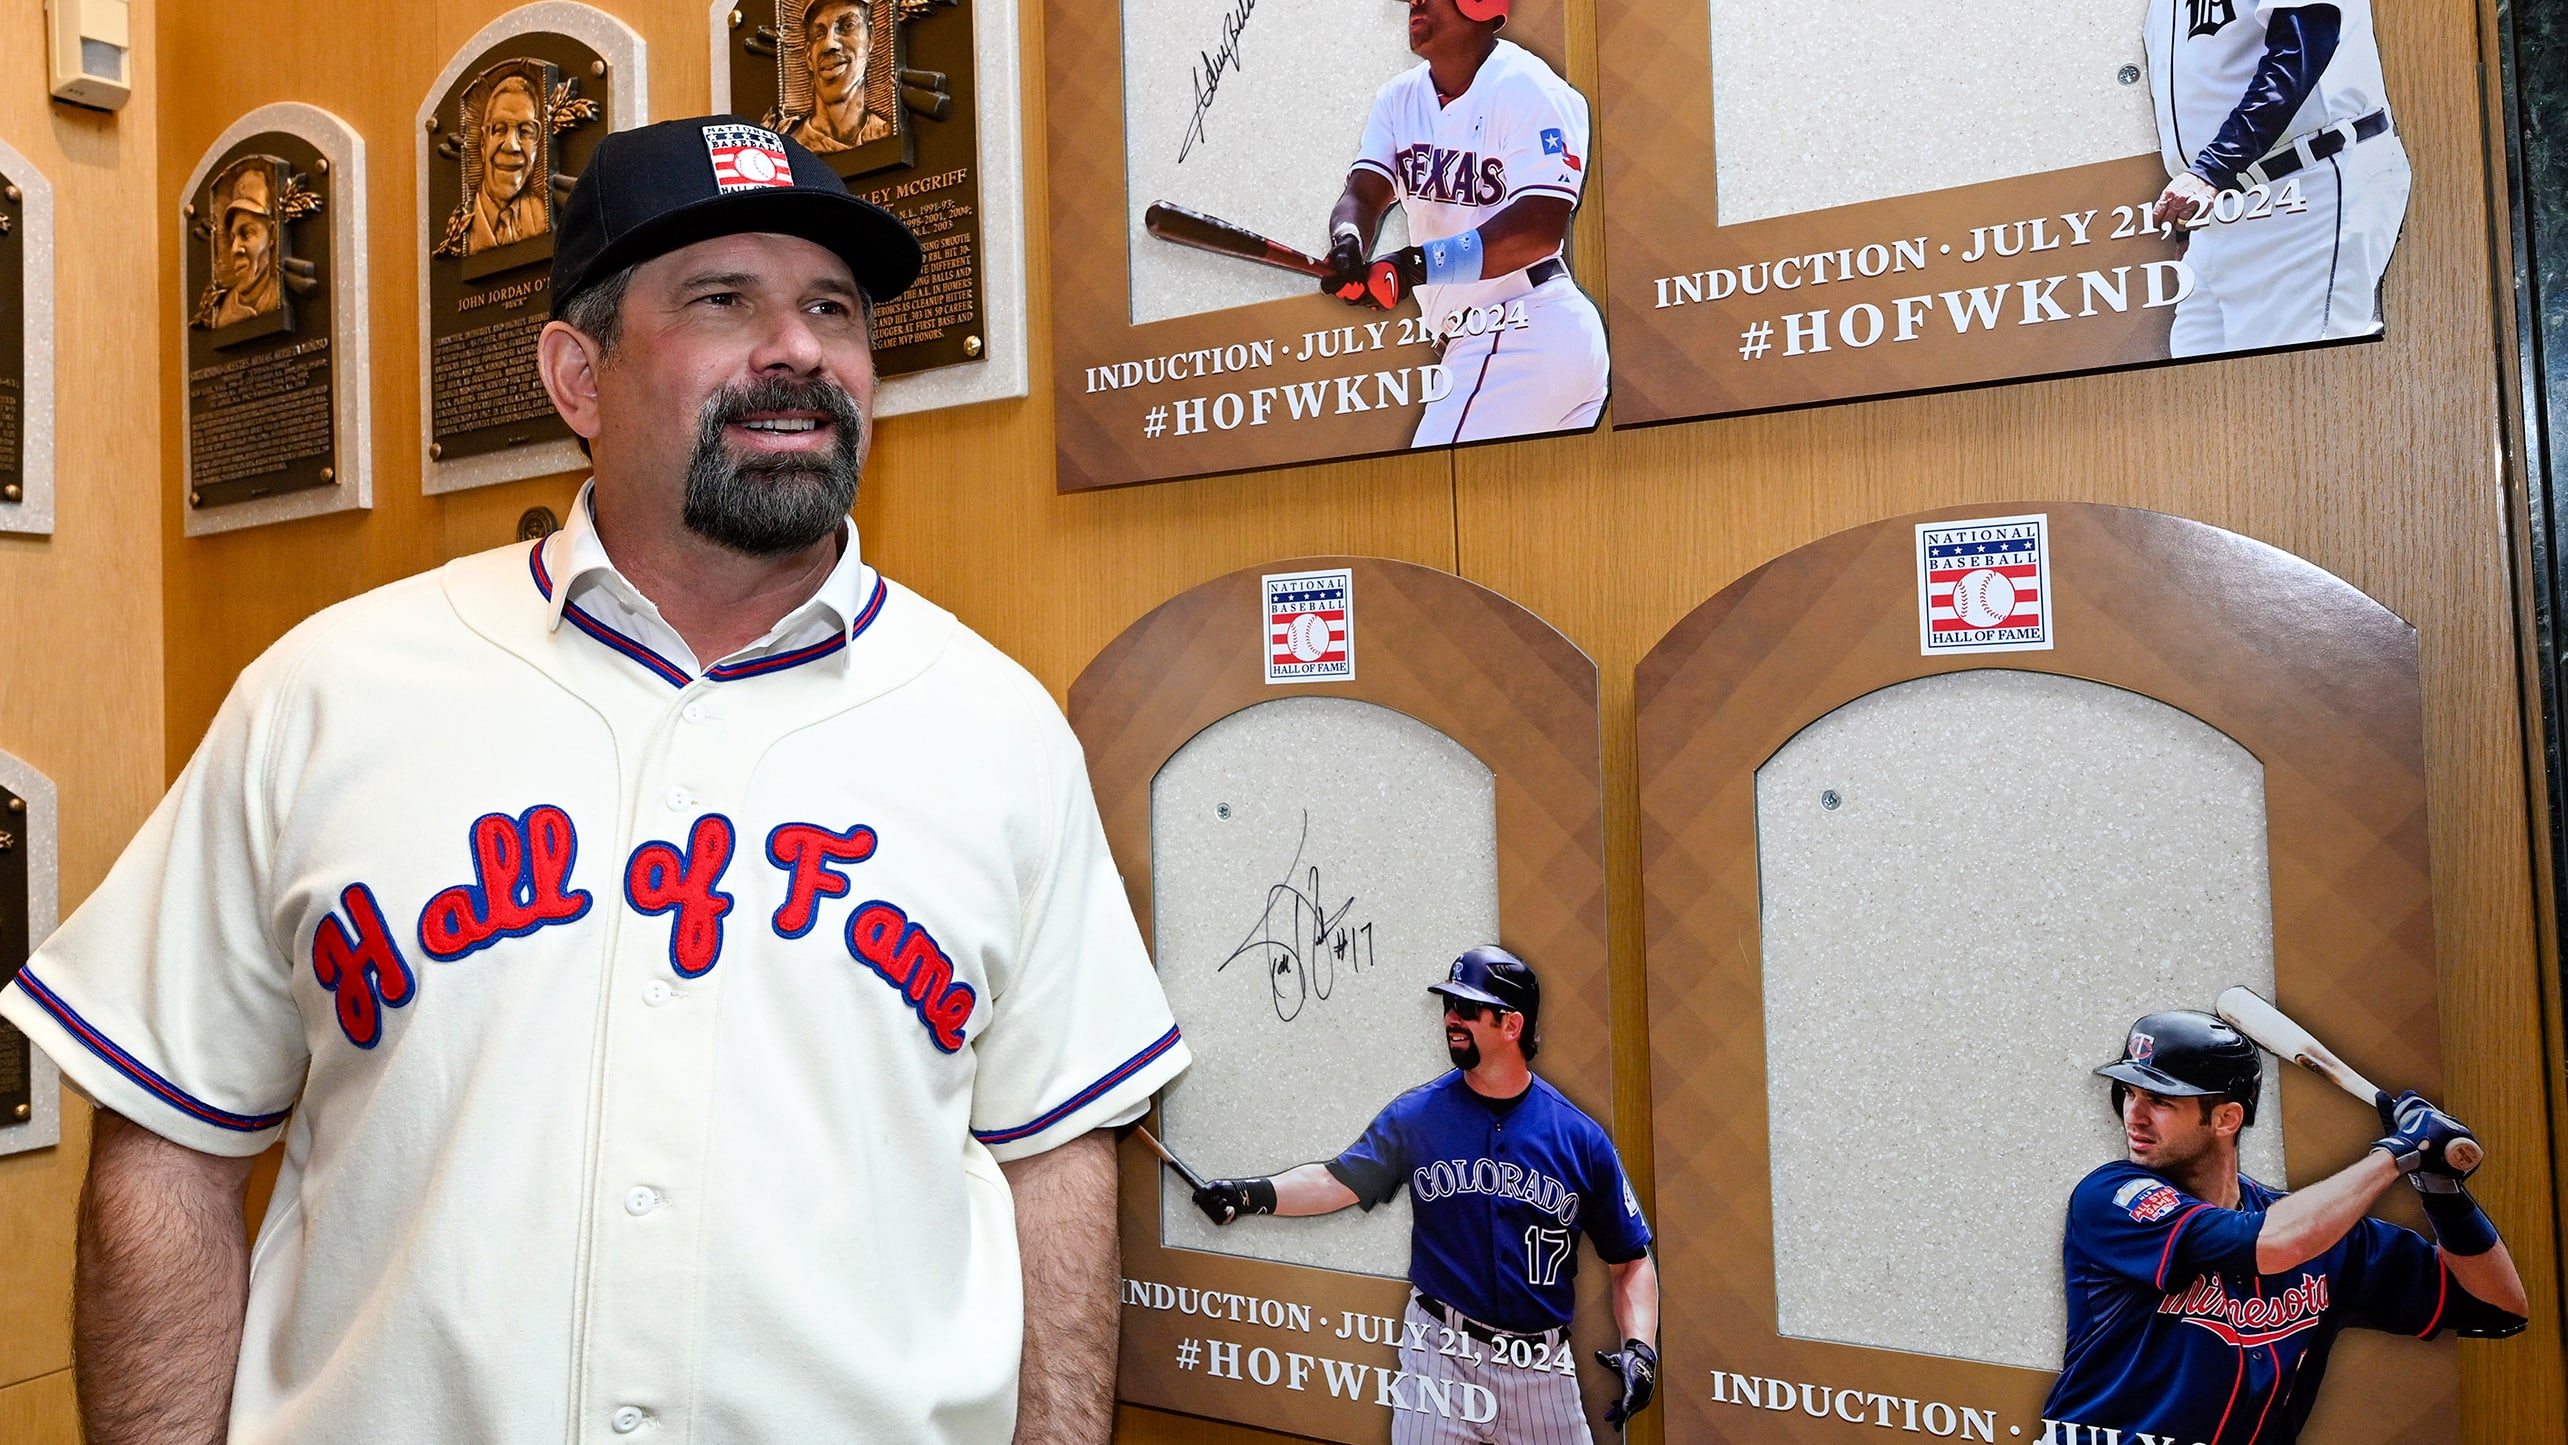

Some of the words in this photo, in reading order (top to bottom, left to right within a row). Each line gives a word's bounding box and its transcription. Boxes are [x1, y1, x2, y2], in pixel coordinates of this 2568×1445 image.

[707, 126, 778, 140] NATIONAL
[712, 140, 783, 154] BASEBALL
[896, 168, 968, 200] MCGRIFF
[1396, 143, 1507, 208] TEXAS
[941, 232, 971, 248] SMOOTH
[1653, 237, 1930, 309] INDUCTION
[1963, 210, 2099, 265] JULY
[2110, 204, 2173, 241] 21,
[2185, 178, 2308, 229] 2024
[931, 255, 972, 273] DIFFERENT
[932, 270, 954, 284] BALLS
[955, 266, 972, 279] AND
[458, 293, 486, 312] JOHN
[488, 281, 532, 304] JORDAN
[933, 283, 942, 295] IN
[943, 277, 973, 293] HOMERS
[901, 301, 911, 312] AS
[912, 294, 944, 310] CLEANUP
[946, 288, 973, 303] HITTER
[1738, 260, 2197, 363] #HOFWKND
[879, 315, 894, 328] AND
[895, 312, 908, 324] HIT
[925, 307, 933, 319] IN
[944, 299, 973, 315] CAREER
[905, 322, 915, 334] AT
[915, 318, 936, 332] FIRST
[938, 314, 956, 328] BASE
[957, 311, 974, 323] AND
[898, 333, 914, 346] MVP
[1085, 338, 1274, 394] INDUCTION
[1297, 320, 1390, 362] JULY
[1398, 315, 1438, 348] 21,
[1449, 301, 1530, 339] 2024
[1143, 364, 1456, 440] #HOFWKND
[1928, 526, 2036, 545] NATIONAL
[1929, 552, 2037, 570] BASEBALL
[1271, 578, 1344, 593] NATIONAL
[1271, 600, 1345, 613] BASEBALL
[1933, 631, 1972, 644] HALL
[1975, 630, 1995, 642] OF
[1998, 627, 2041, 641] FAME
[1273, 664, 1300, 675] HALL
[1301, 663, 1316, 674] OF
[1317, 662, 1347, 673] FAME
[312, 804, 593, 1050] Hall
[624, 812, 736, 979] of
[764, 822, 977, 1055] Fame
[1333, 921, 1374, 973] #17
[1412, 1157, 1580, 1227] COLORADO
[2134, 1202, 2151, 1218] ALL
[2149, 1187, 2174, 1203] STAR
[2146, 1195, 2173, 1215] GAME
[1524, 1225, 1571, 1286] 17
[1121, 1278, 1313, 1333] INDUCTION
[1336, 1311, 1431, 1352] JULY
[1439, 1327, 1482, 1367] 21,
[1491, 1334, 1576, 1376] 2024
[1176, 1337, 1499, 1424] #HOFWKND
[1710, 1370, 1997, 1444] INDUCTION
